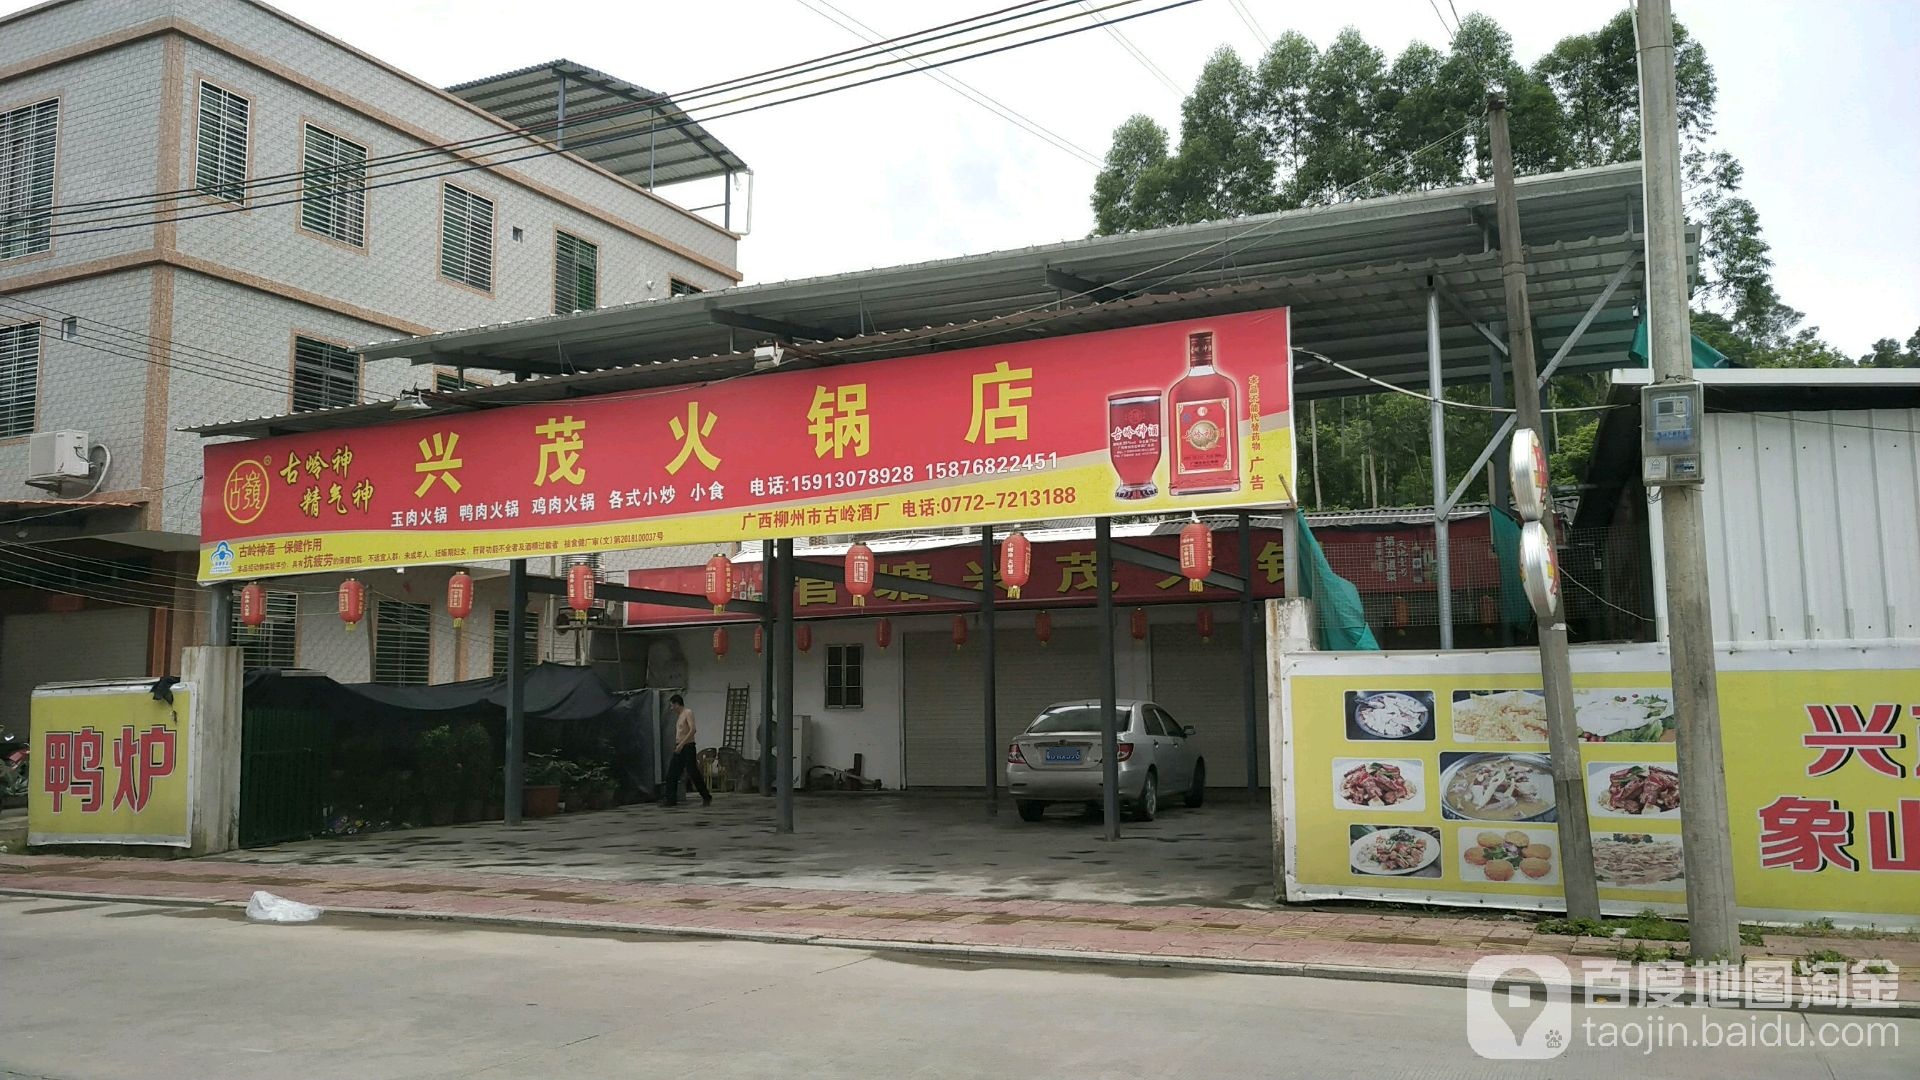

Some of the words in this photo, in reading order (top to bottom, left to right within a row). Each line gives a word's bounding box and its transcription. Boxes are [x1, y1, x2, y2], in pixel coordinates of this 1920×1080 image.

[414, 361, 1033, 498] 兴茂火锅店
[280, 445, 353, 485] 古岭神
[390, 506, 448, 529] 玉肉火锅
[459, 500, 520, 523] 鸭肉火锅
[532, 493, 596, 516] 鸡肉火锅
[608, 485, 676, 510] 各式小炒
[690, 481, 726, 502] 小食
[750, 465, 915, 497] 电话:15913078928
[925, 451, 1058, 480] 15876822451
[1249, 456, 1265, 491] 广告
[300, 479, 375, 518] 精气神
[741, 502, 890, 531] 广西柳州市古岭酒厂
[902, 486, 1076, 518] 电话:0772-7213188
[44, 725, 178, 814] 鸭炉
[1803, 704, 1920, 778] 兴
